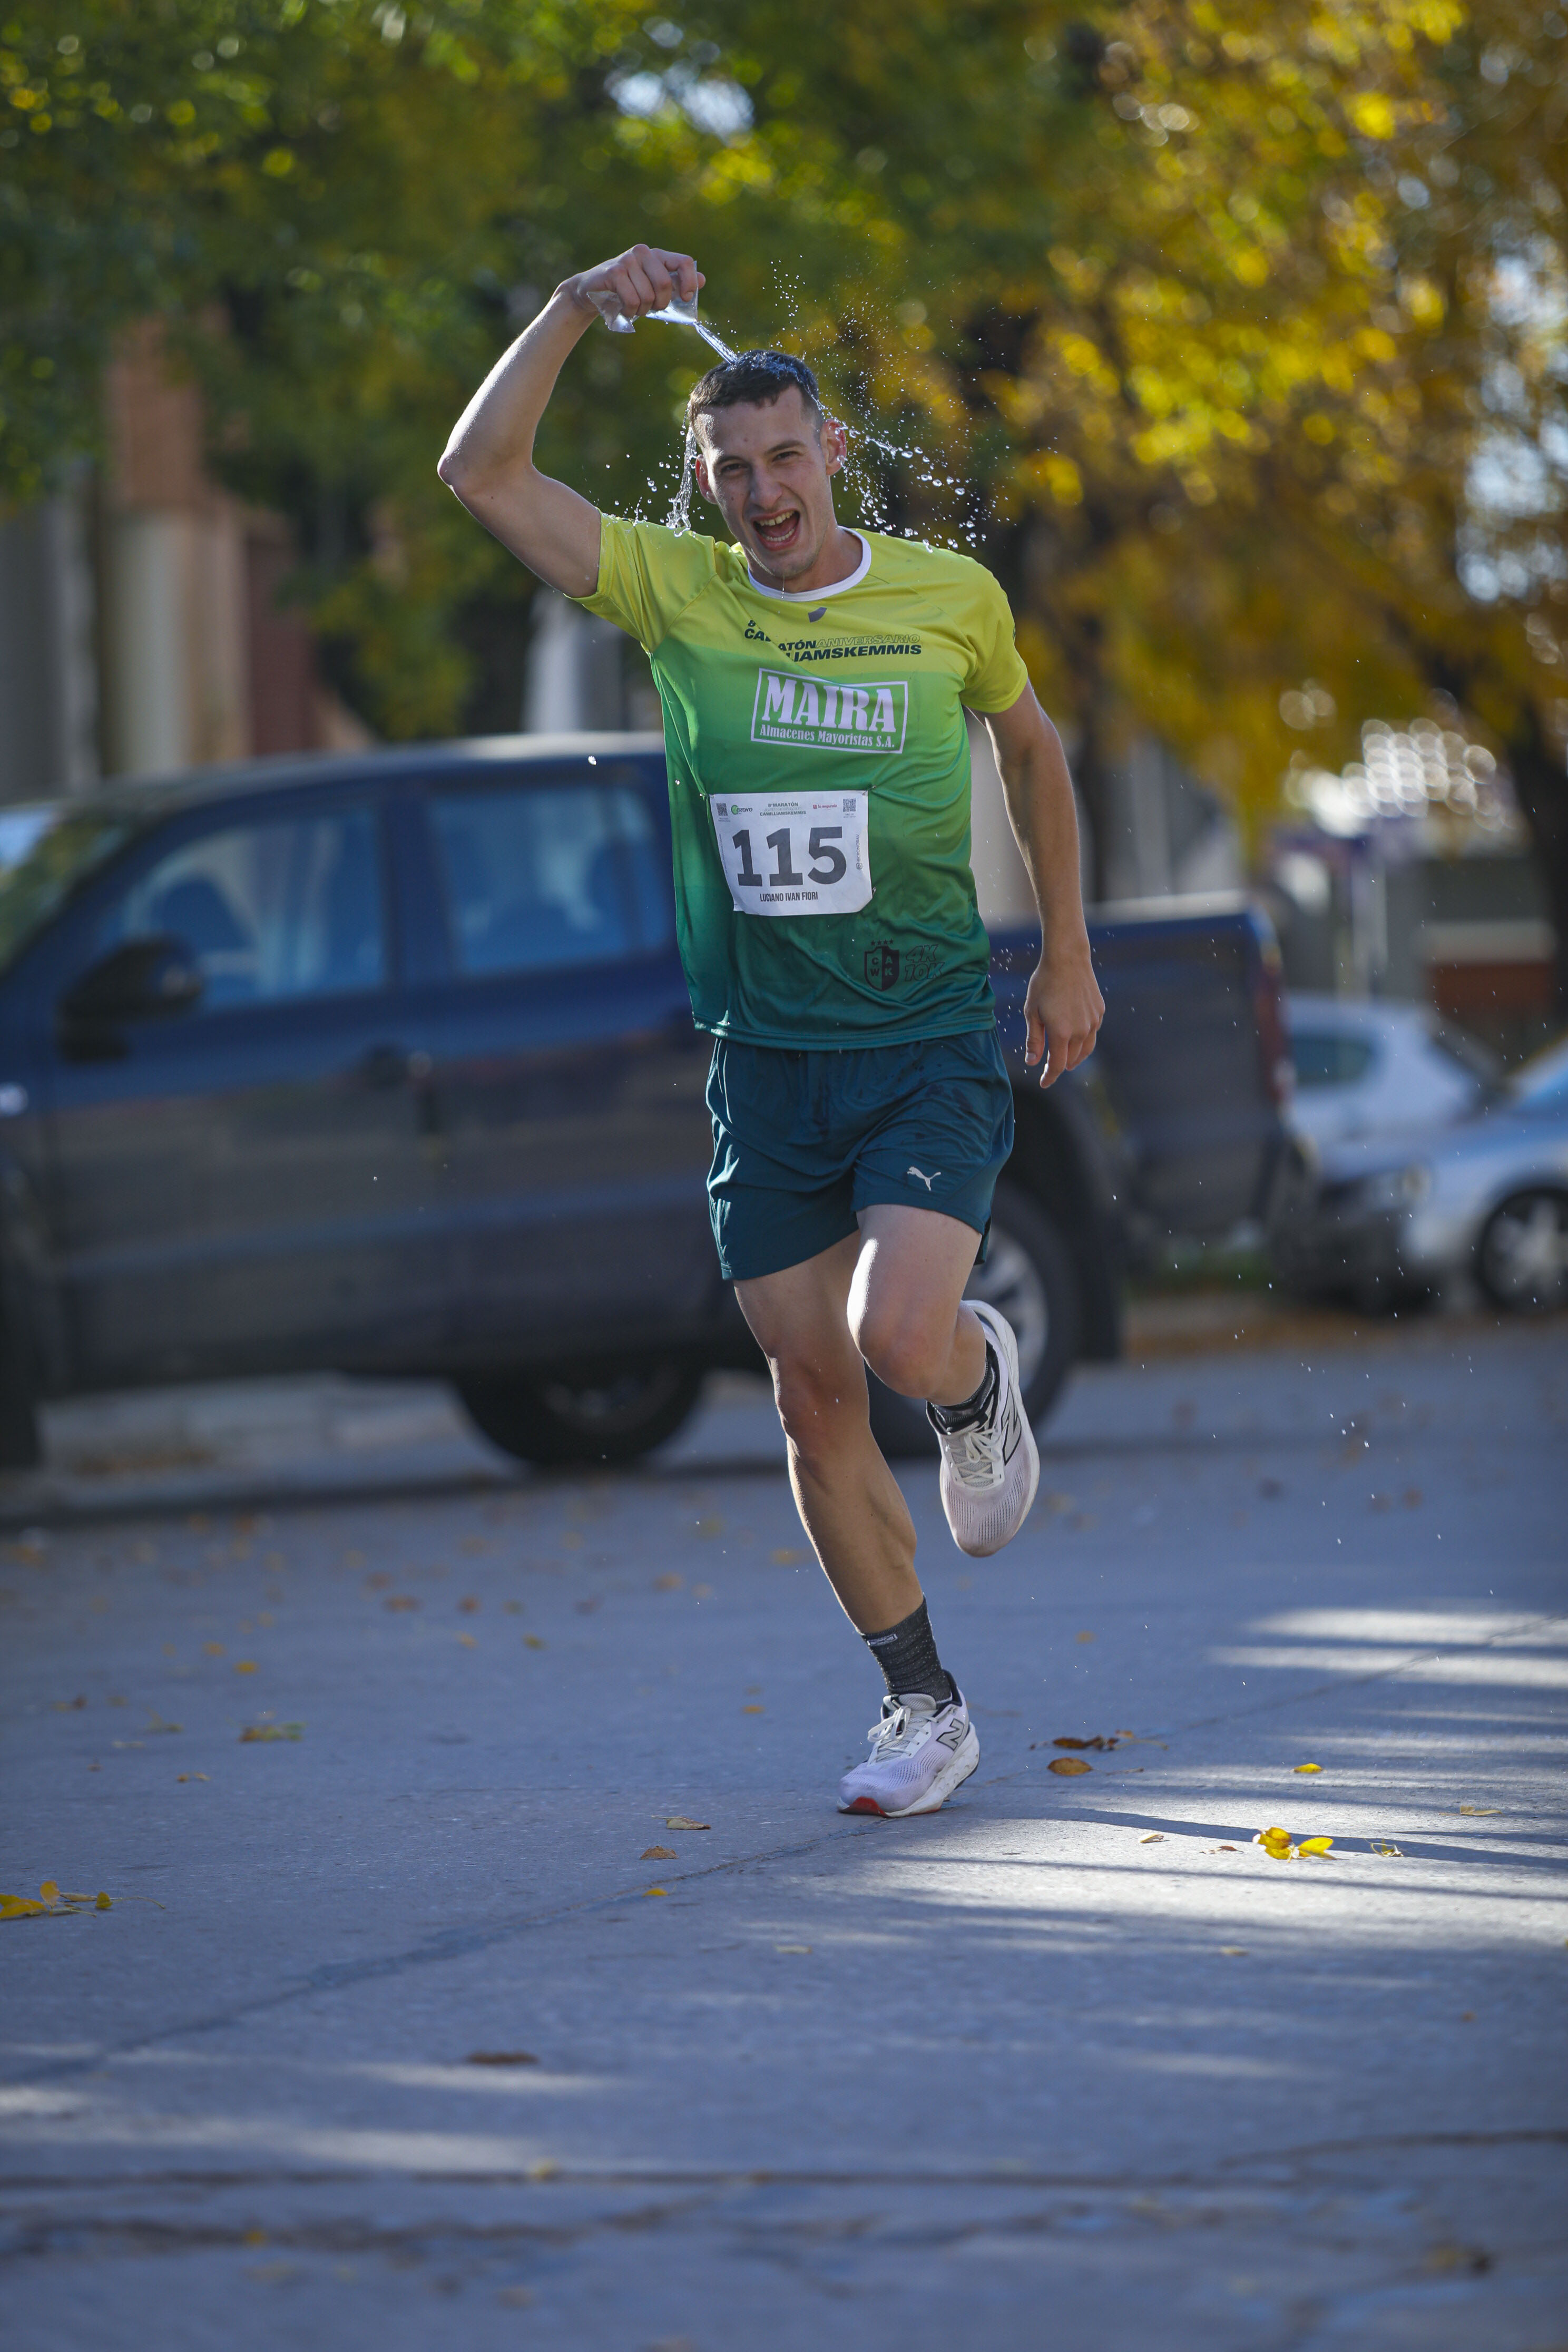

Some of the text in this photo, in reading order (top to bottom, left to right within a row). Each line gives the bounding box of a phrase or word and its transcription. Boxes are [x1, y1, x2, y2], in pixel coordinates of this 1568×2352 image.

[761, 675, 896, 732] MAIRA
[760, 724, 895, 748] Almacenes Mayoristas S.A.
[732, 826, 847, 887] 115
[760, 891, 818, 902] LUCIANO IVAN FIORI
[906, 944, 938, 963] 4K
[905, 962, 945, 982] 10K
